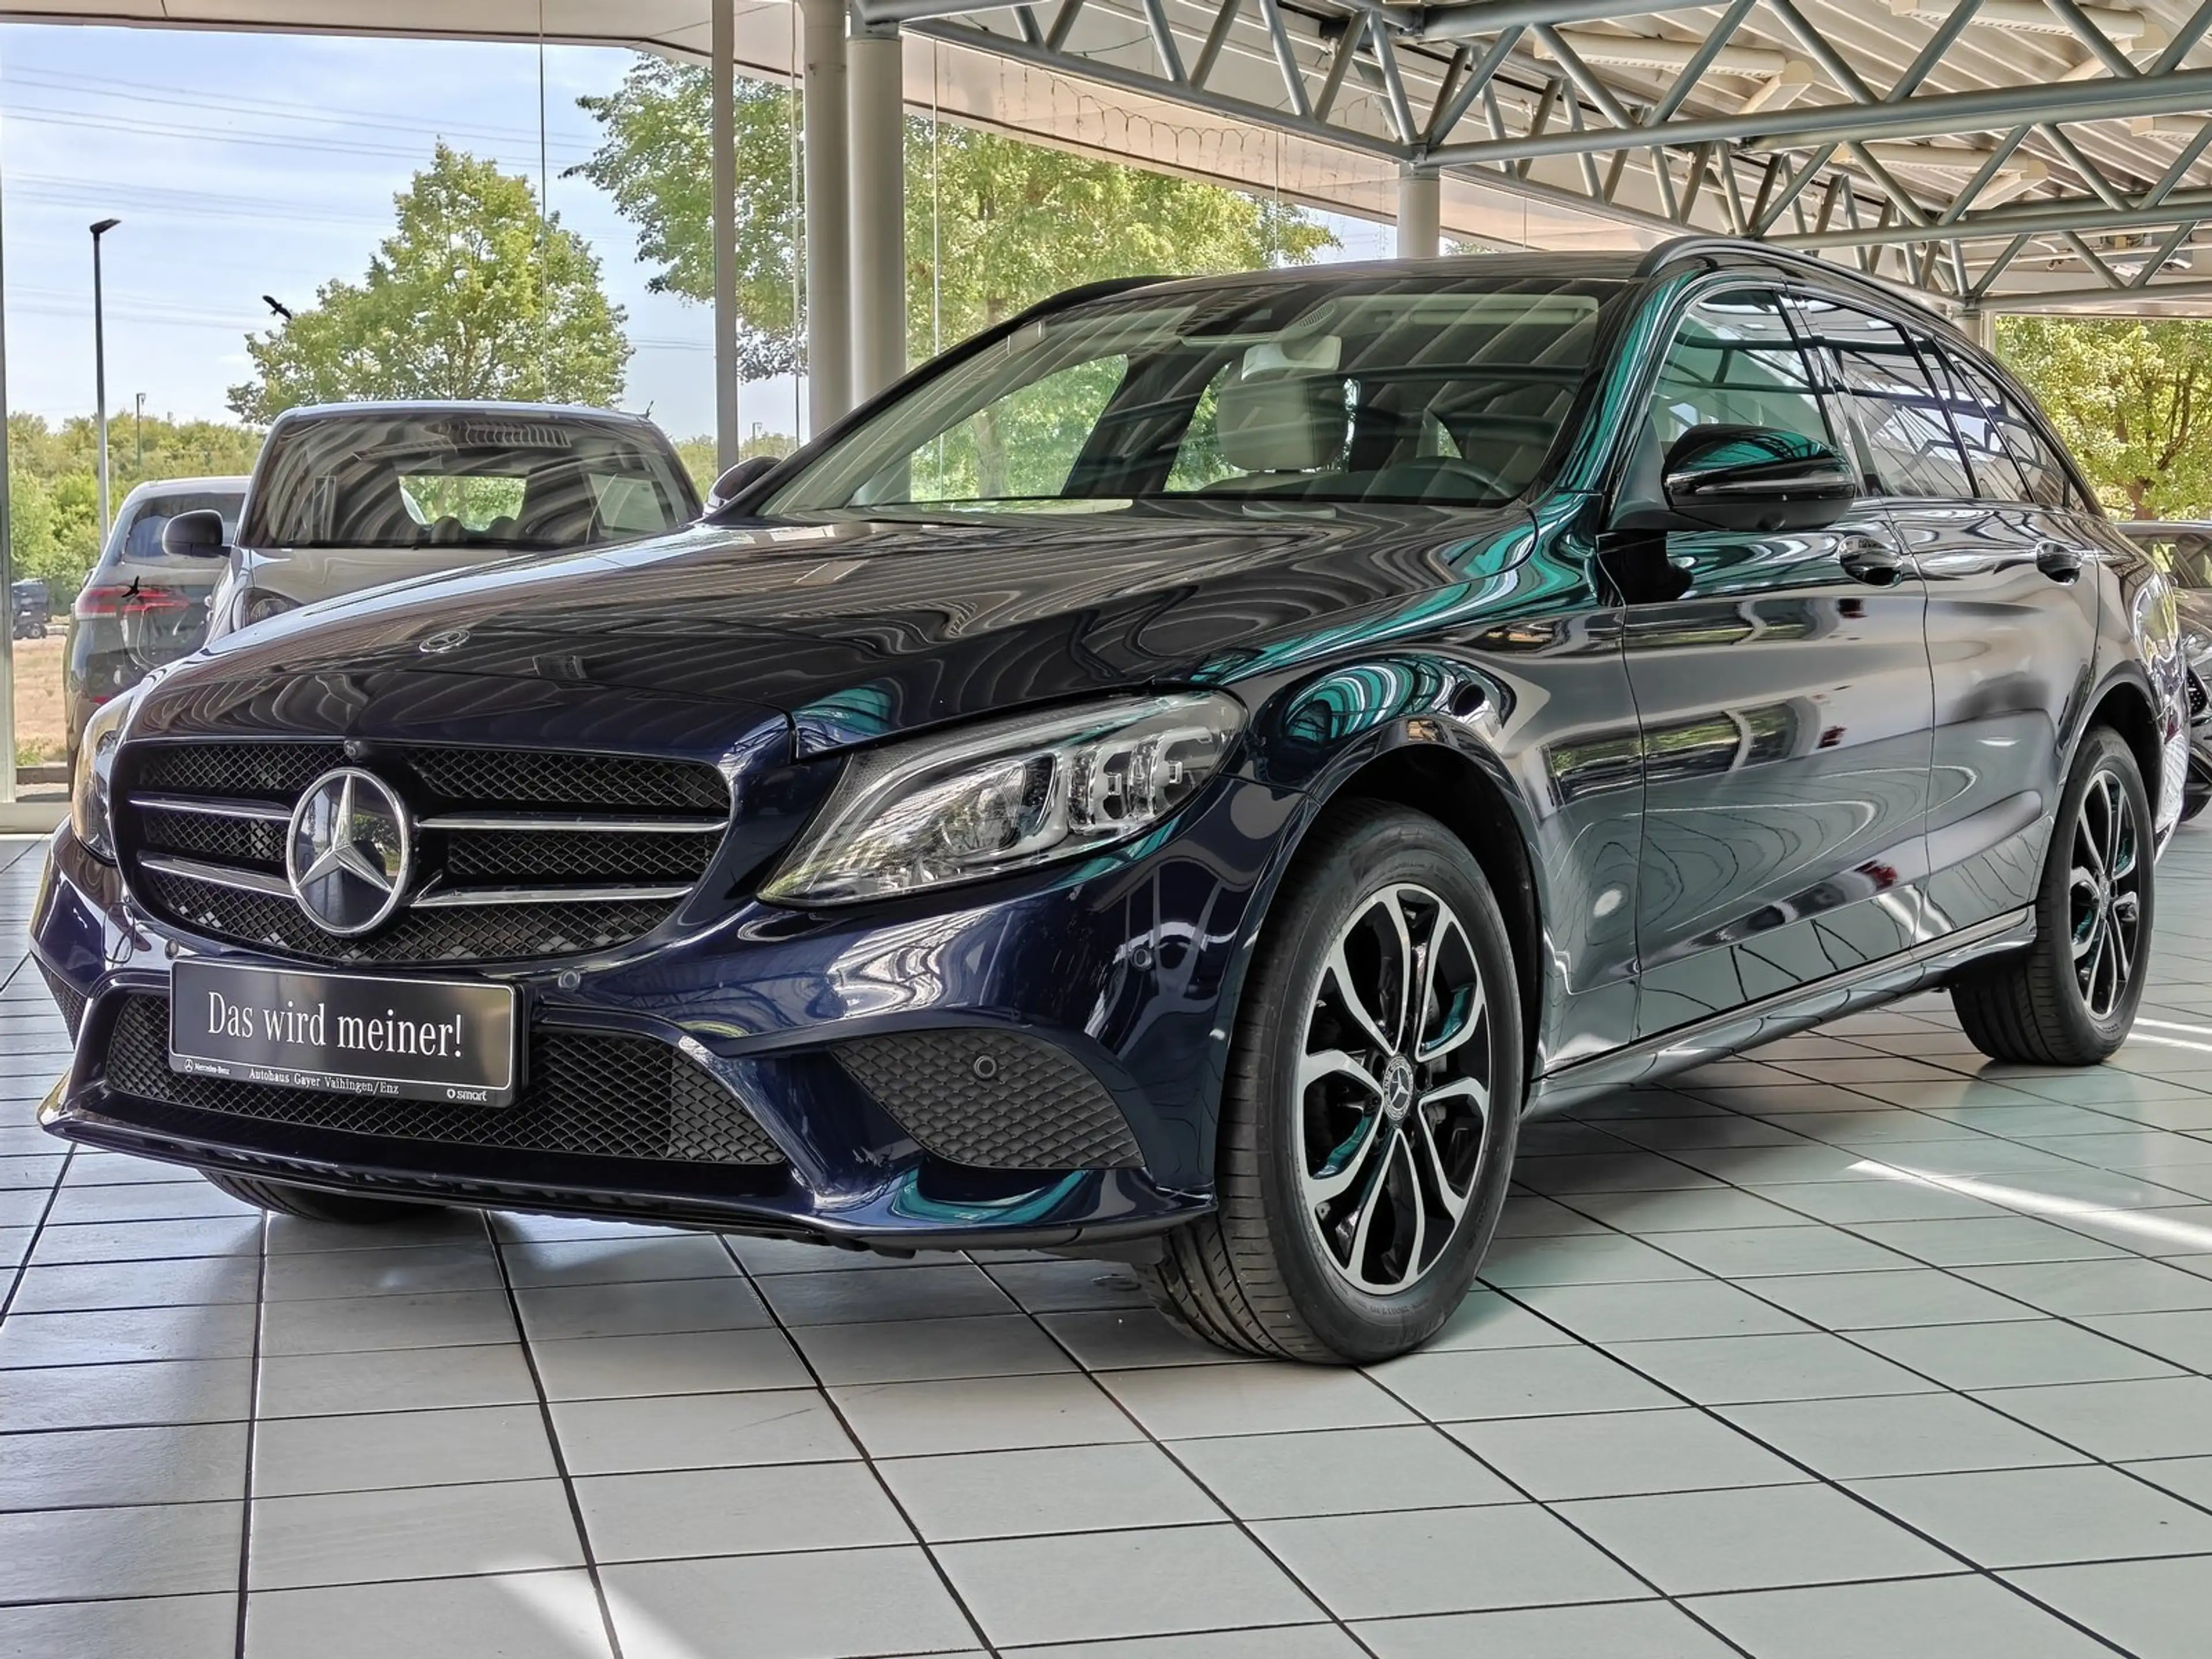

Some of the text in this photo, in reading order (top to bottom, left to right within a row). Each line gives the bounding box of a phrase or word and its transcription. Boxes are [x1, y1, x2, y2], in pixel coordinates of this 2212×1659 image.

[208, 991, 462, 1058] Das wird meiner!
[249, 1068, 399, 1094] Autohaus Gayer Vaihingen/Enz
[456, 1090, 487, 1101] smart
